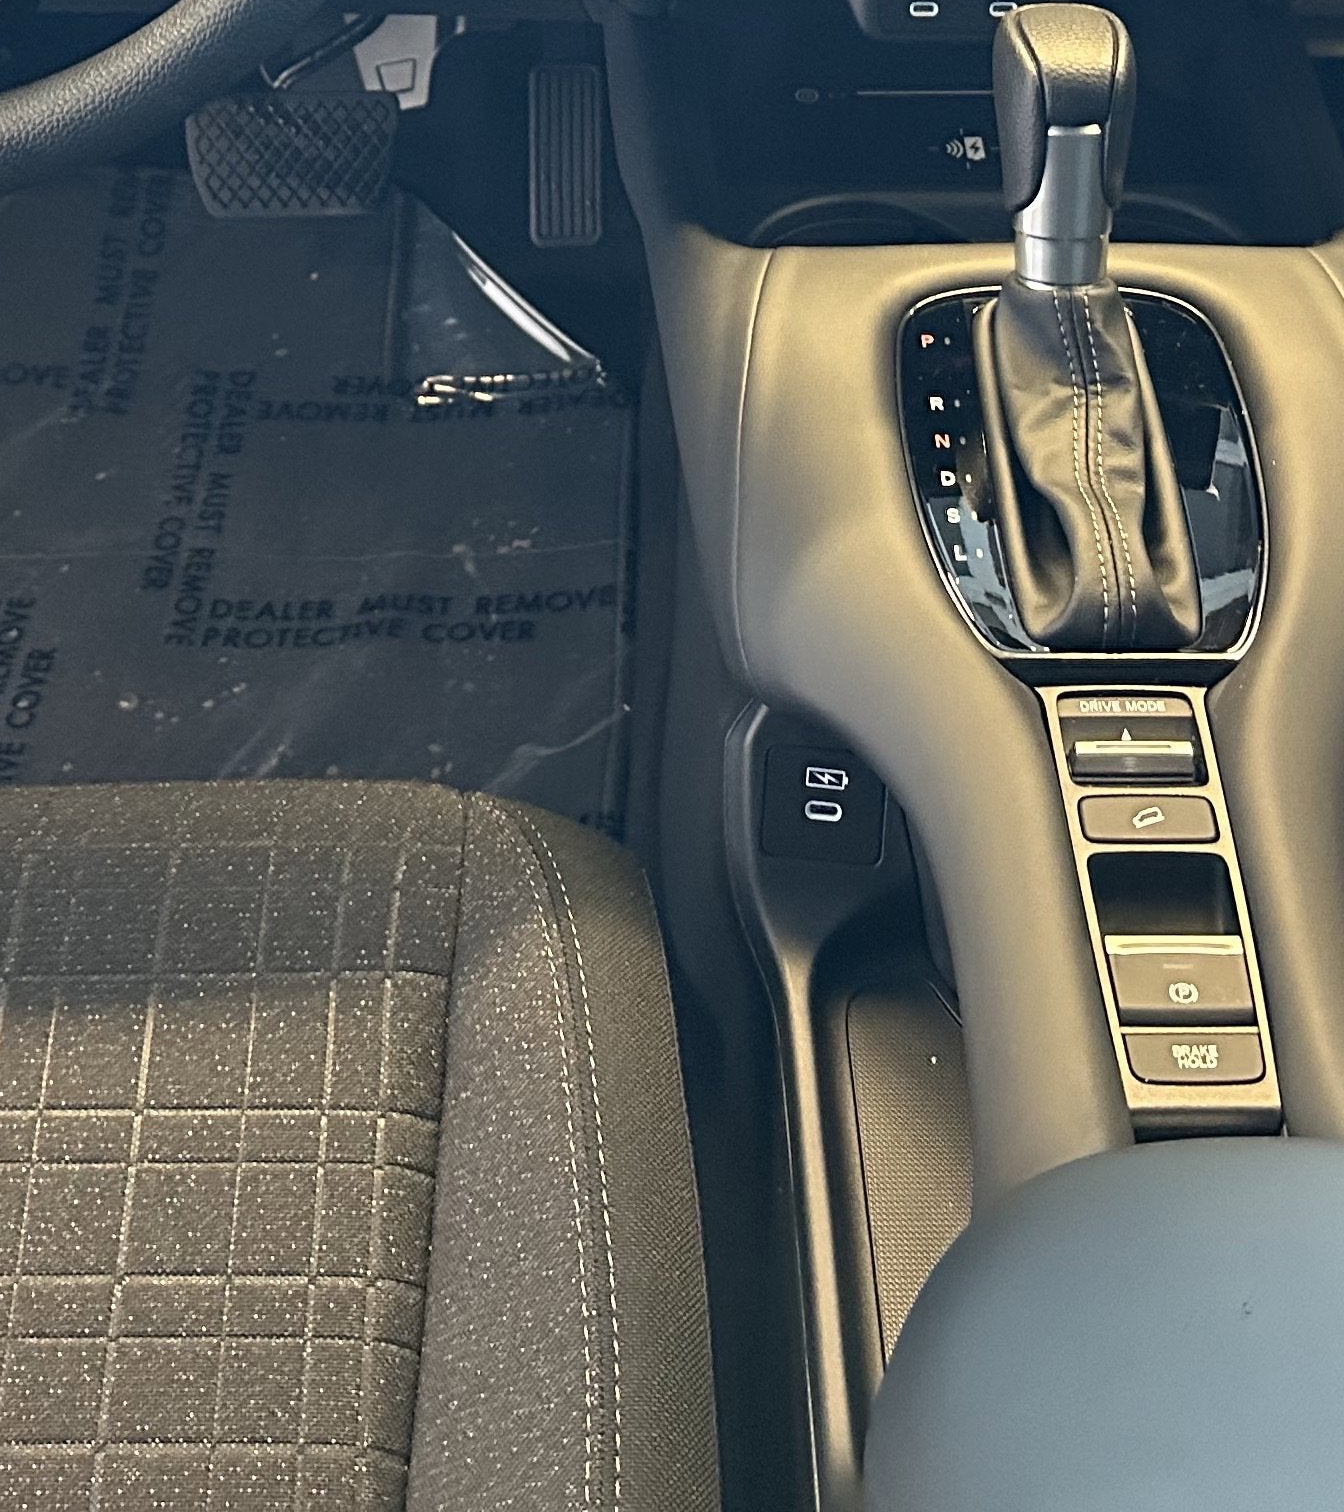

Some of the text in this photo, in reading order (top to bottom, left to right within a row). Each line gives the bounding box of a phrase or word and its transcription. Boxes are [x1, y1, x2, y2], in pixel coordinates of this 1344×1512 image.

[93, 233, 129, 306] MUST
[920, 334, 934, 348] P
[256, 399, 389, 424] REMOVE
[929, 396, 944, 411] R
[934, 433, 950, 449] N
[940, 470, 956, 487] D
[193, 472, 234, 536] MUST
[946, 507, 961, 524] S
[140, 515, 187, 592] COVER
[953, 544, 967, 561] L
[163, 546, 217, 648] REMOVE
[208, 583, 619, 623] DEALER MUST REMOVE
[201, 616, 537, 650] PROTECTIVE COVER
[3, 646, 58, 731] COVER
[1079, 700, 1166, 713] DRIVE MODE
[1171, 1044, 1219, 1057] BRAKE
[1177, 1056, 1218, 1069] HOLD
